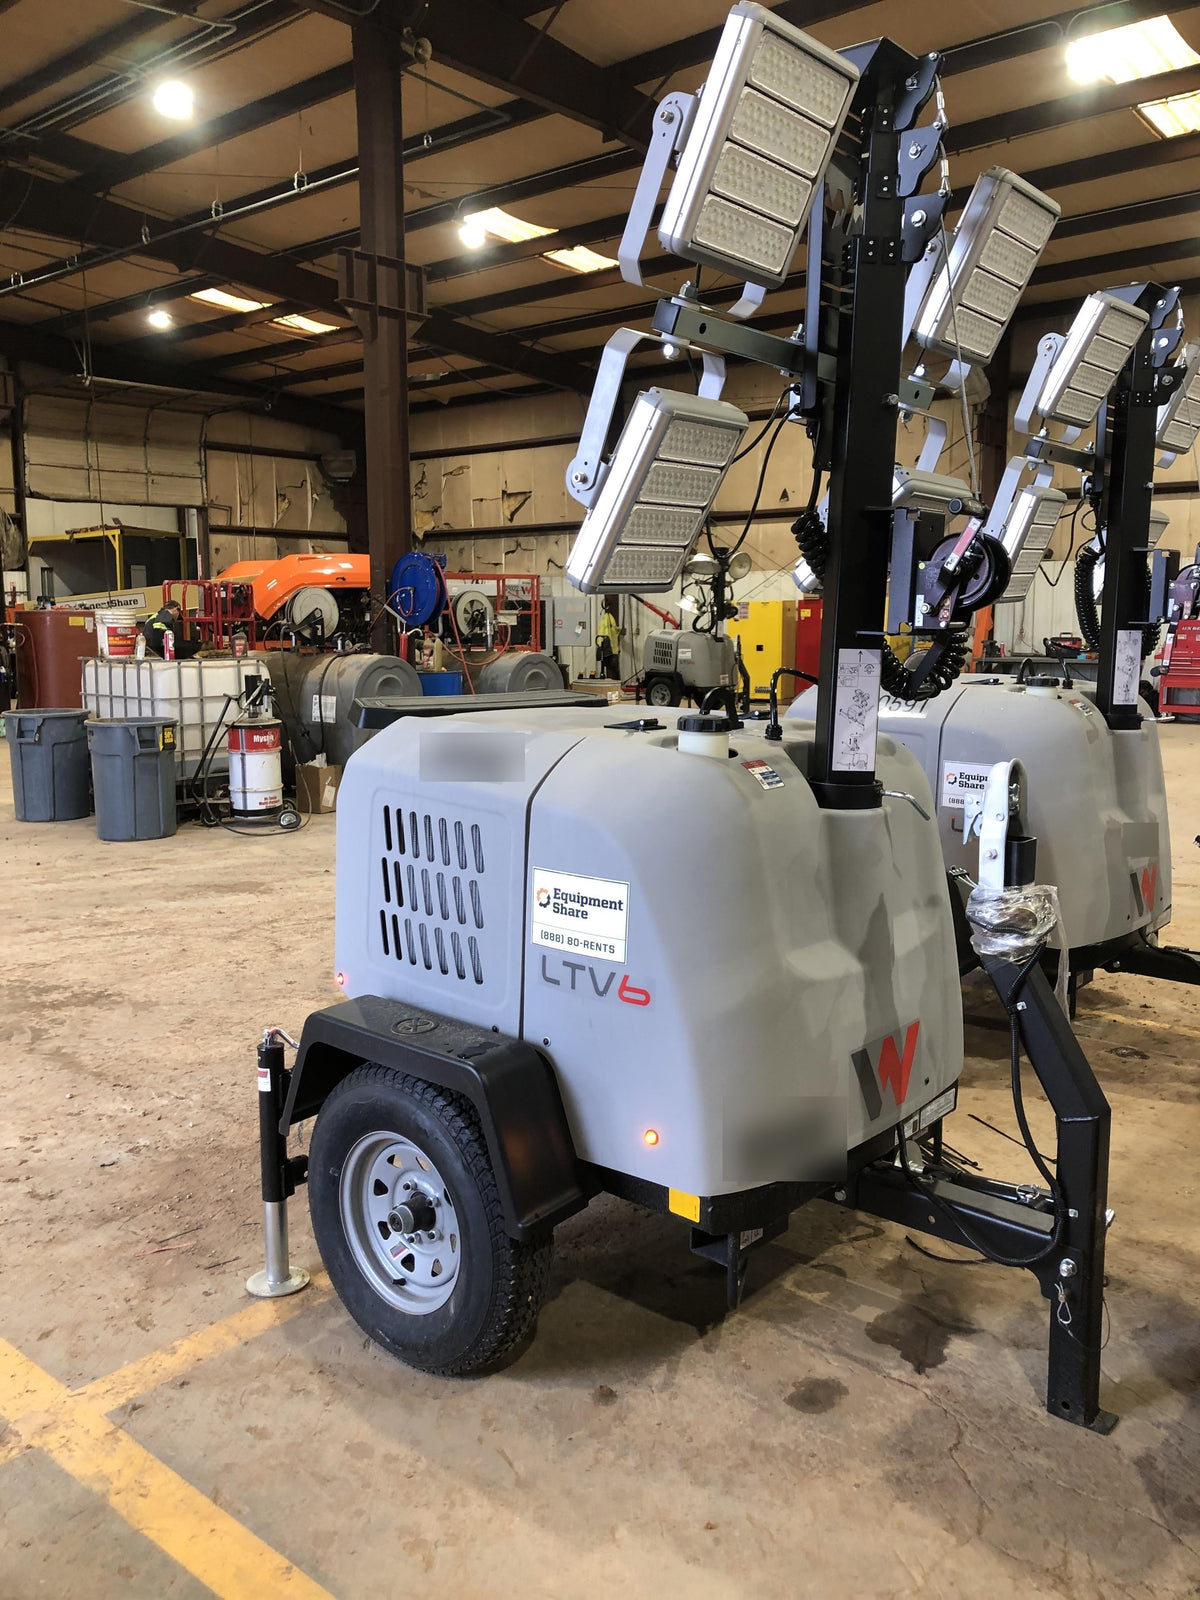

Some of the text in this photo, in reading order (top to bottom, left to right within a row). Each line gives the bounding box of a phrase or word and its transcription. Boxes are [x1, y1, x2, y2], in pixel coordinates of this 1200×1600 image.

[253, 734, 276, 744] Myst
[958, 781, 985, 790] Share
[553, 888, 624, 911] Equipment
[552, 902, 589, 920] Share
[540, 930, 615, 954] (888) 80-RENTS
[542, 954, 651, 1006] LTV6
